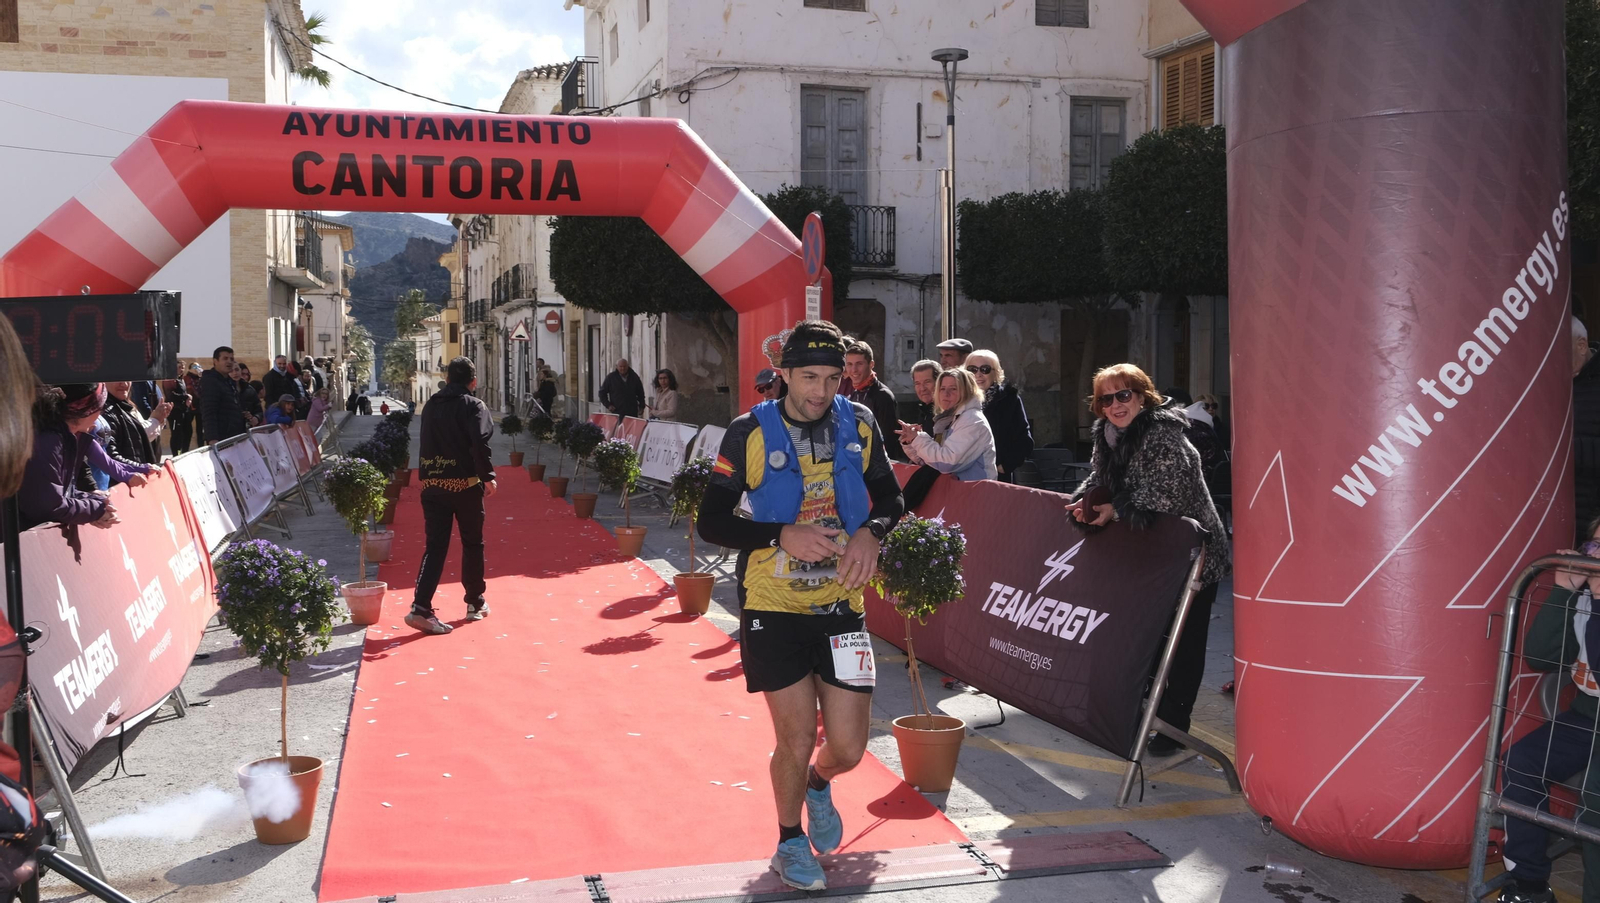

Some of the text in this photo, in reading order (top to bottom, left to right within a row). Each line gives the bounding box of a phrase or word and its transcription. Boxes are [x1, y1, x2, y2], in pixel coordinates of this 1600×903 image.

[282, 111, 592, 145] AYUNTAMIENTO
[292, 150, 582, 201] CANTORIA
[1332, 190, 1570, 508] www.teamergy.es
[124, 575, 168, 643] TEAMERGY
[981, 581, 1110, 645] TEAMERGY
[53, 629, 119, 715] TEAMERGY
[855, 650, 873, 672] 73
[988, 636, 1053, 671] www.teamergy.es
